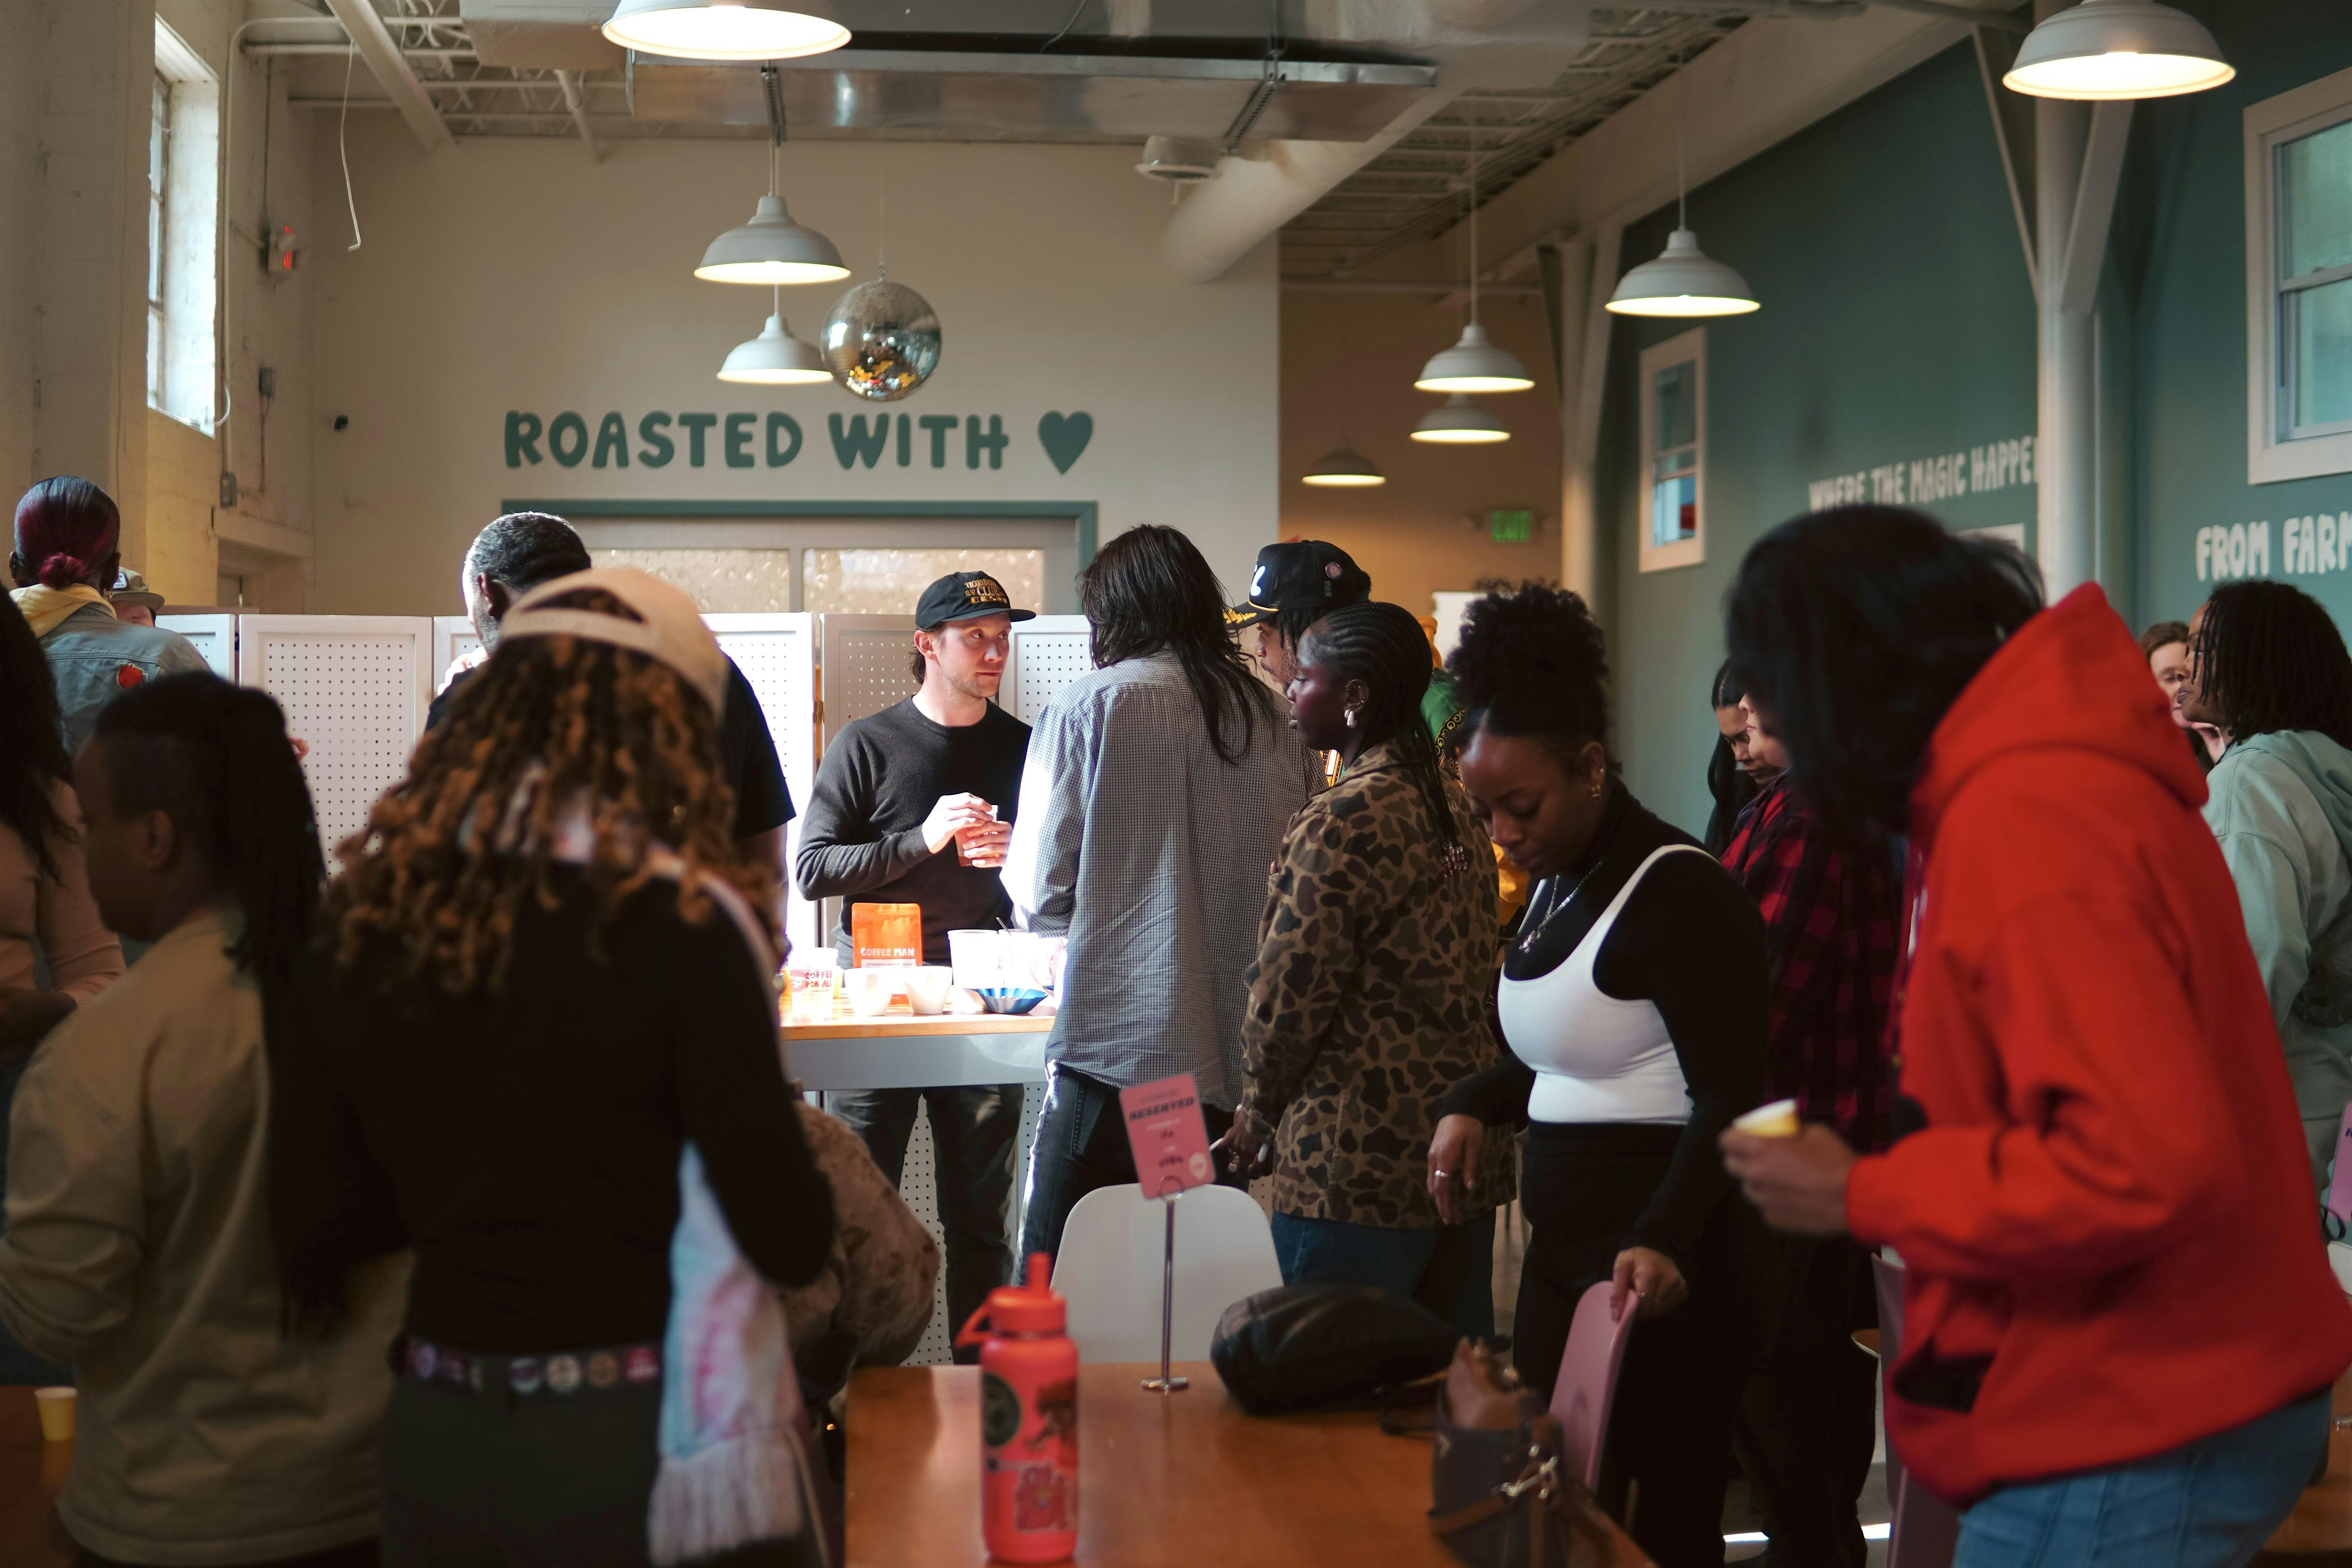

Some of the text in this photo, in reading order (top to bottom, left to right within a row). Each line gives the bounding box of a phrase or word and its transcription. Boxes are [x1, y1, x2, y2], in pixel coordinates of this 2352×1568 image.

[504, 411, 1009, 469] ROASTED WITH
[1809, 435, 2037, 513] WHERE THE MAGIC HAPPE
[2196, 520, 2269, 581] FROM
[860, 948, 914, 957] COFFEE MAN
[805, 970, 833, 979] COFFEE
[1129, 1096, 1194, 1120] RESERVED
